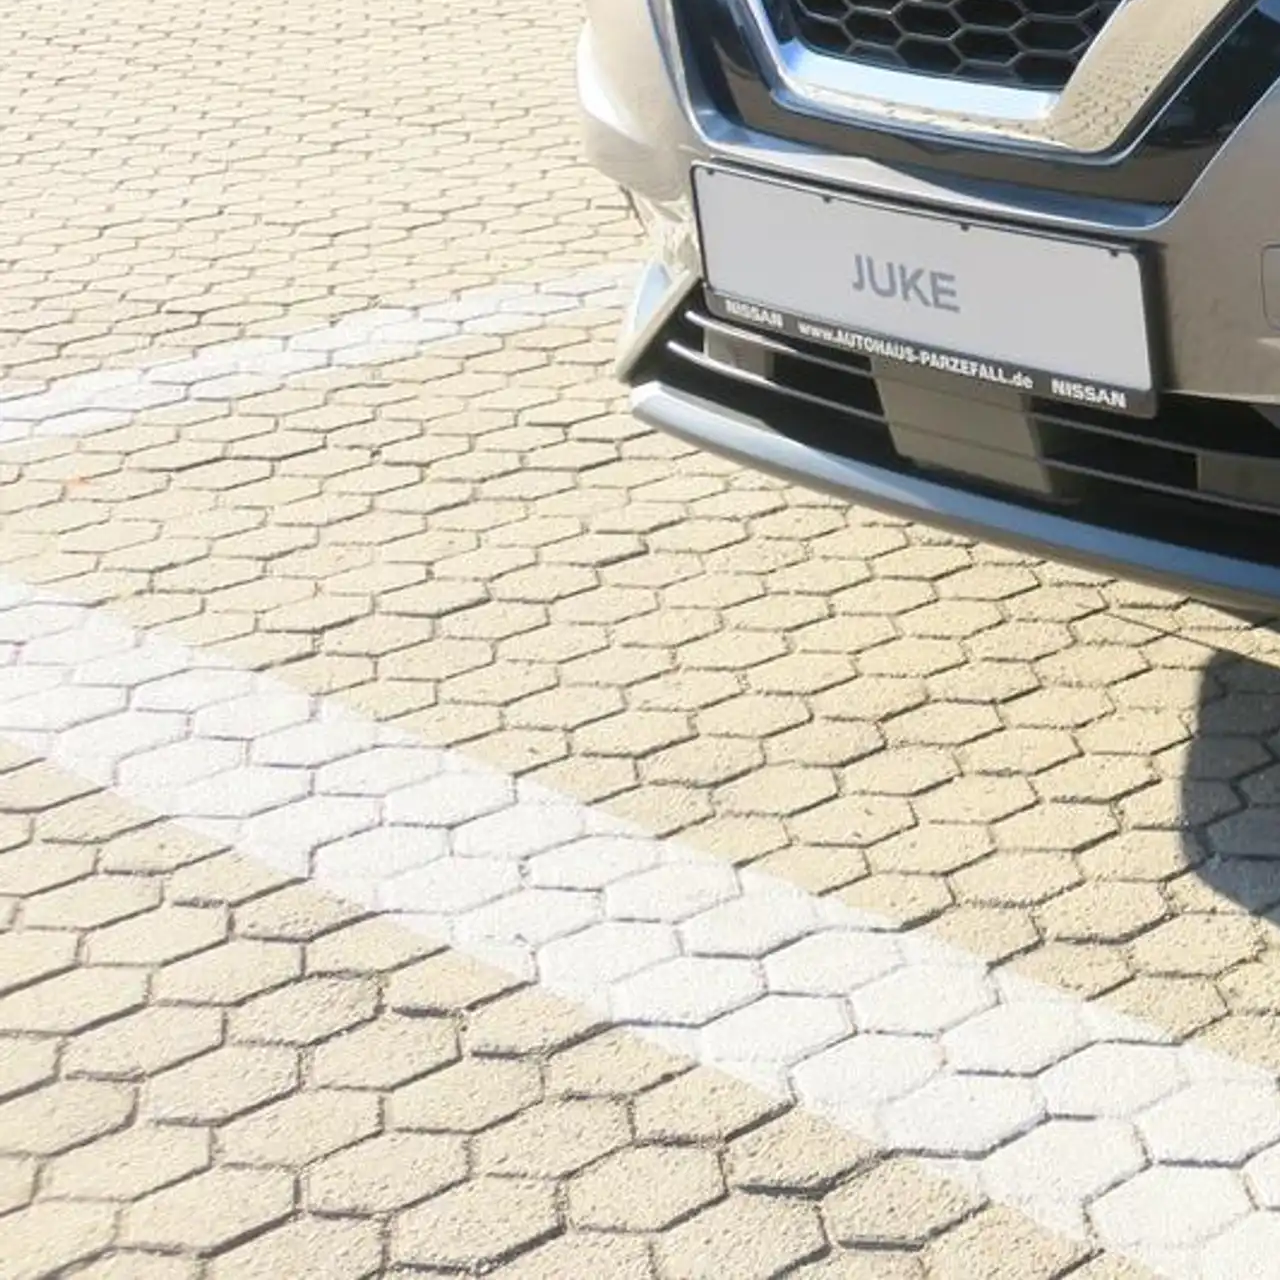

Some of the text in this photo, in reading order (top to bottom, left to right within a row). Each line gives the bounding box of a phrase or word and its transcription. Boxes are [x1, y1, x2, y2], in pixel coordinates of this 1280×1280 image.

[852, 254, 961, 313] JUKE
[726, 298, 1128, 409] NISSAN www.AUTOHAUS-PARZEFALL.de NISSAN
